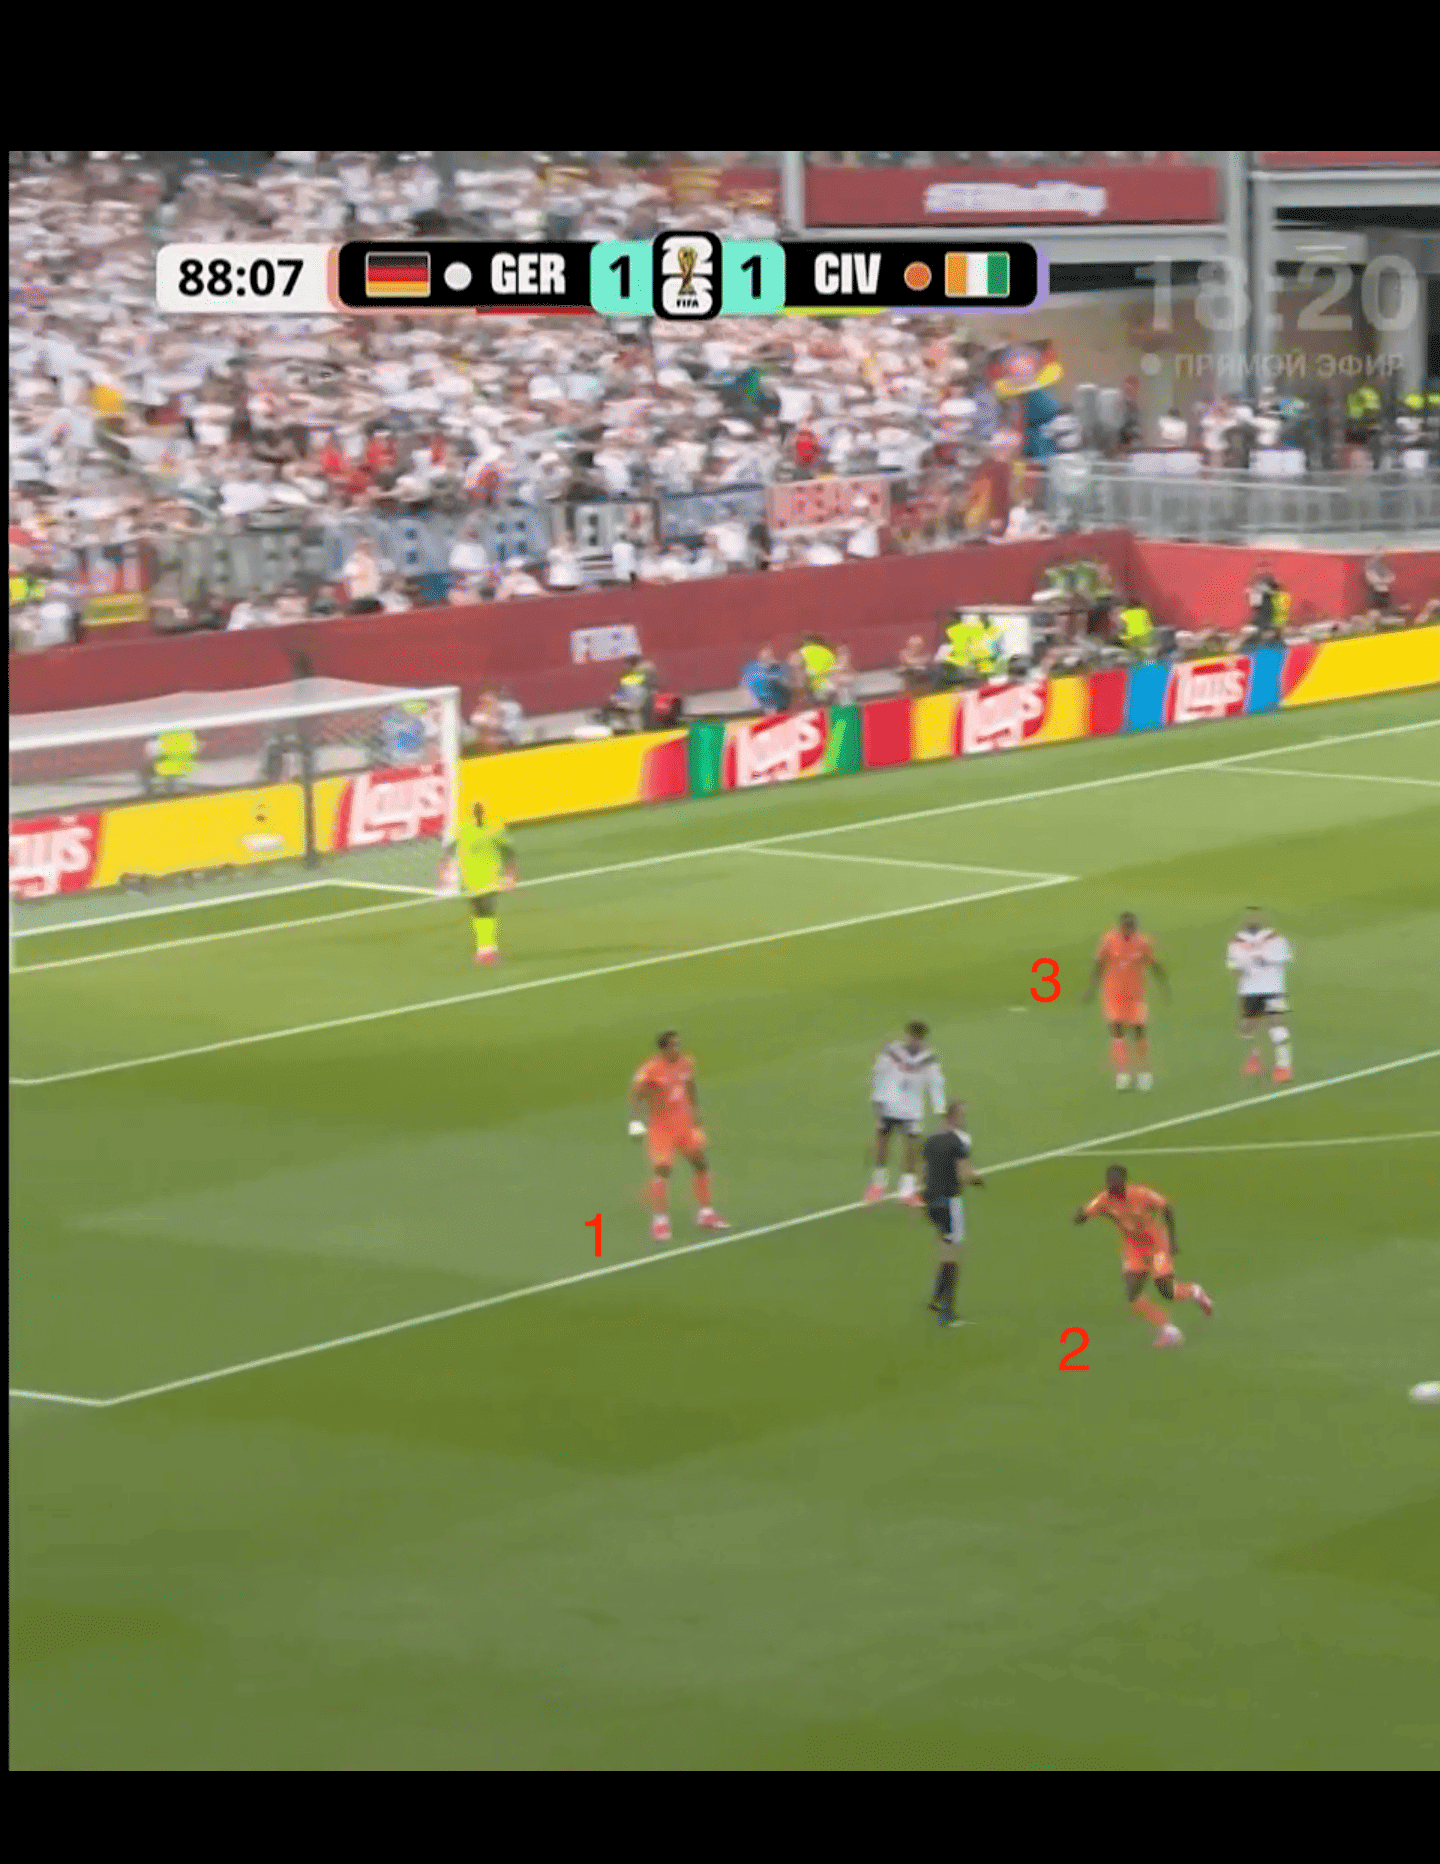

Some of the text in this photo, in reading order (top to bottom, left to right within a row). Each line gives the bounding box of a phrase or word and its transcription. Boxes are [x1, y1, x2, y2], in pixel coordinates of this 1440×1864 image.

[737, 710, 822, 786] Lays
[964, 682, 1042, 753] Lays
[9, 816, 92, 897] ay's
